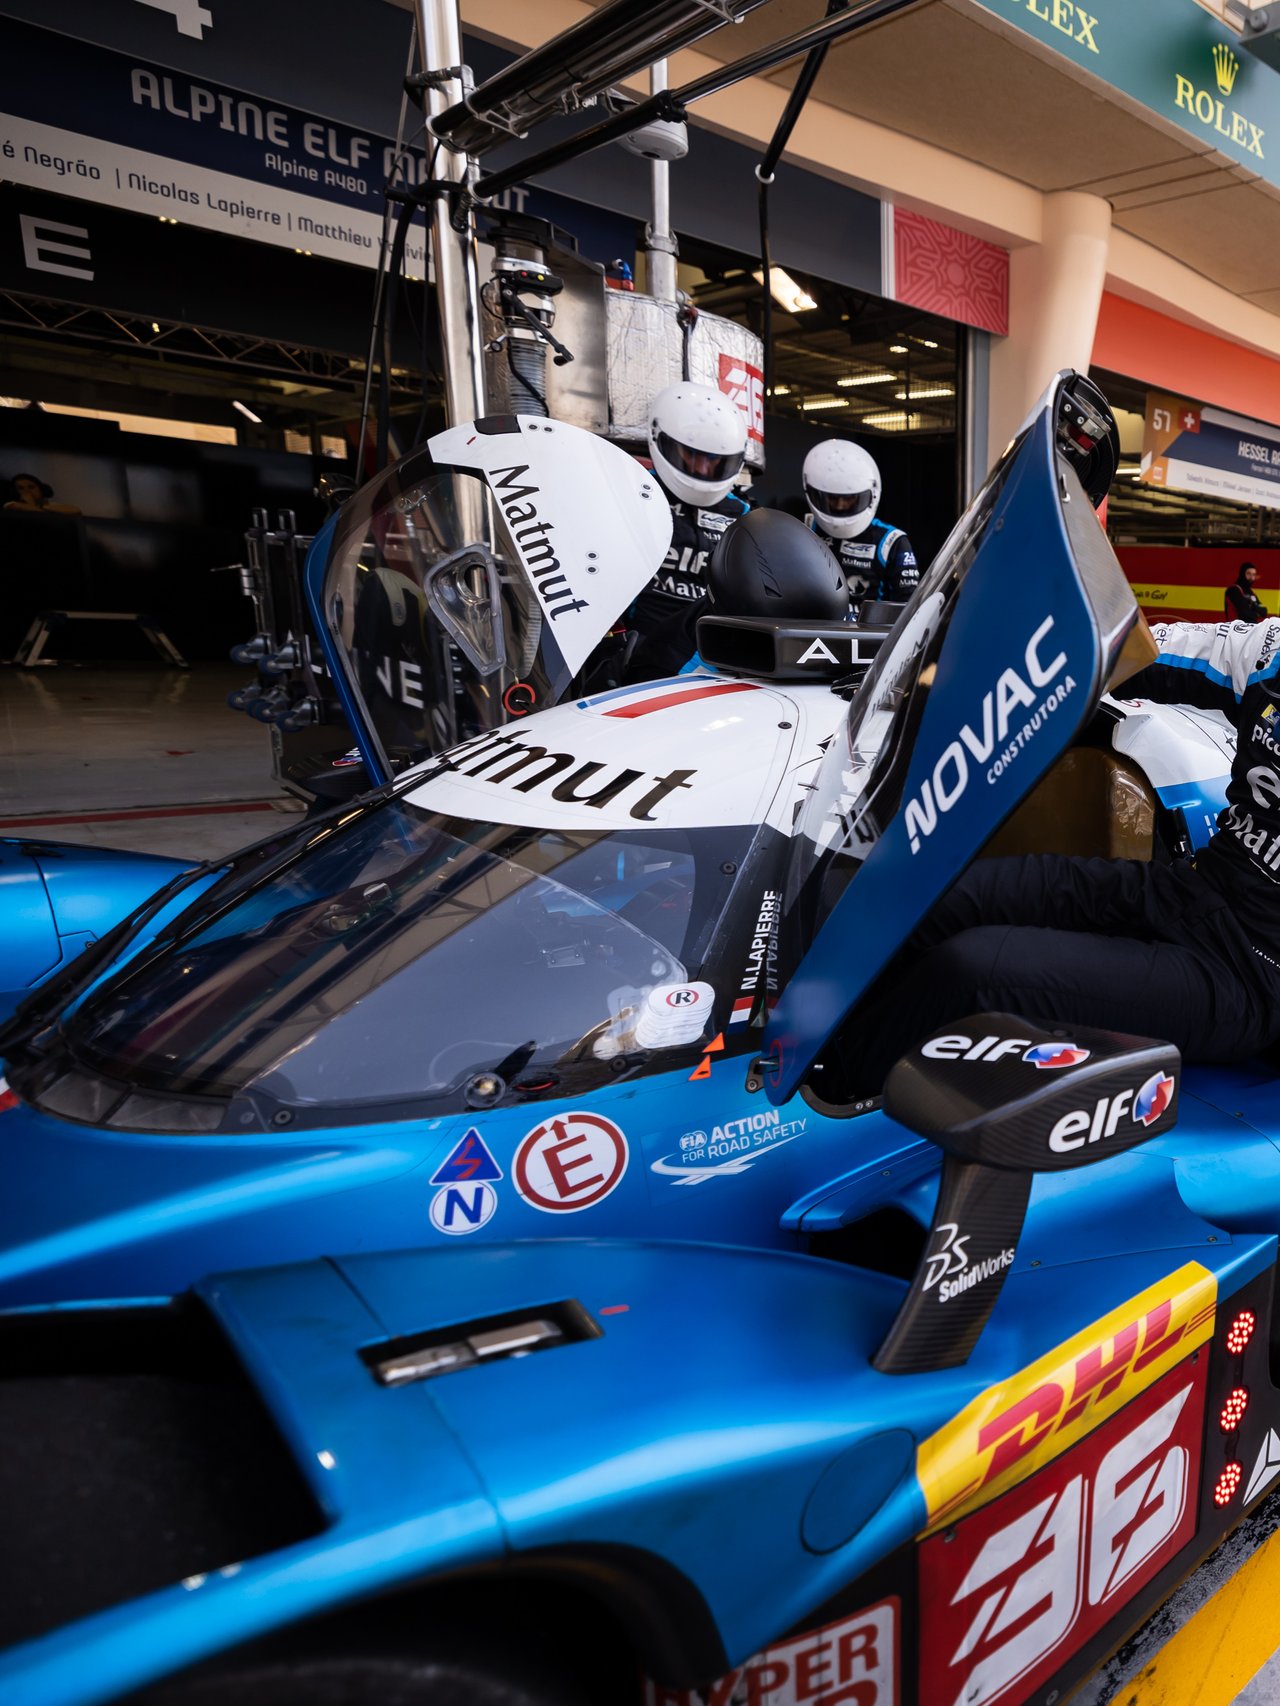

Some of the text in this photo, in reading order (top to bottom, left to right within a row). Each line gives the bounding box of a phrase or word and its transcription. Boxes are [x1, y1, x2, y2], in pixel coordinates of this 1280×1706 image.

[1023, 0, 1100, 54] LEX
[130, 68, 290, 148] ALPINE
[303, 121, 371, 169] ELF
[1175, 74, 1266, 159] ROLEX
[264, 152, 368, 196] Alpine A480
[128, 172, 200, 206] Nicolas
[206, 191, 282, 226] Lapierre
[297, 215, 373, 249] Matthieu
[1152, 408, 1172, 433] 57
[488, 463, 591, 622] Matmut
[660, 546, 710, 575] elf
[904, 613, 1068, 856] NOVAC
[986, 674, 1078, 785] CONSTRUTORA
[433, 729, 699, 822] atmut
[740, 889, 776, 990] N.LAPIERRE
[674, 991, 692, 1005] R
[920, 1034, 1032, 1062] elf
[681, 1109, 780, 1150] FIA ACTION
[682, 1118, 808, 1164] FOR ROAD SAFETY
[1048, 1088, 1135, 1153] elf
[443, 1186, 485, 1227] N
[938, 1247, 1015, 1303] SolidWorks
[977, 1298, 1188, 1488] DHL
[948, 1381, 1196, 1706] 36
[656, 1622, 880, 1706] YPER
